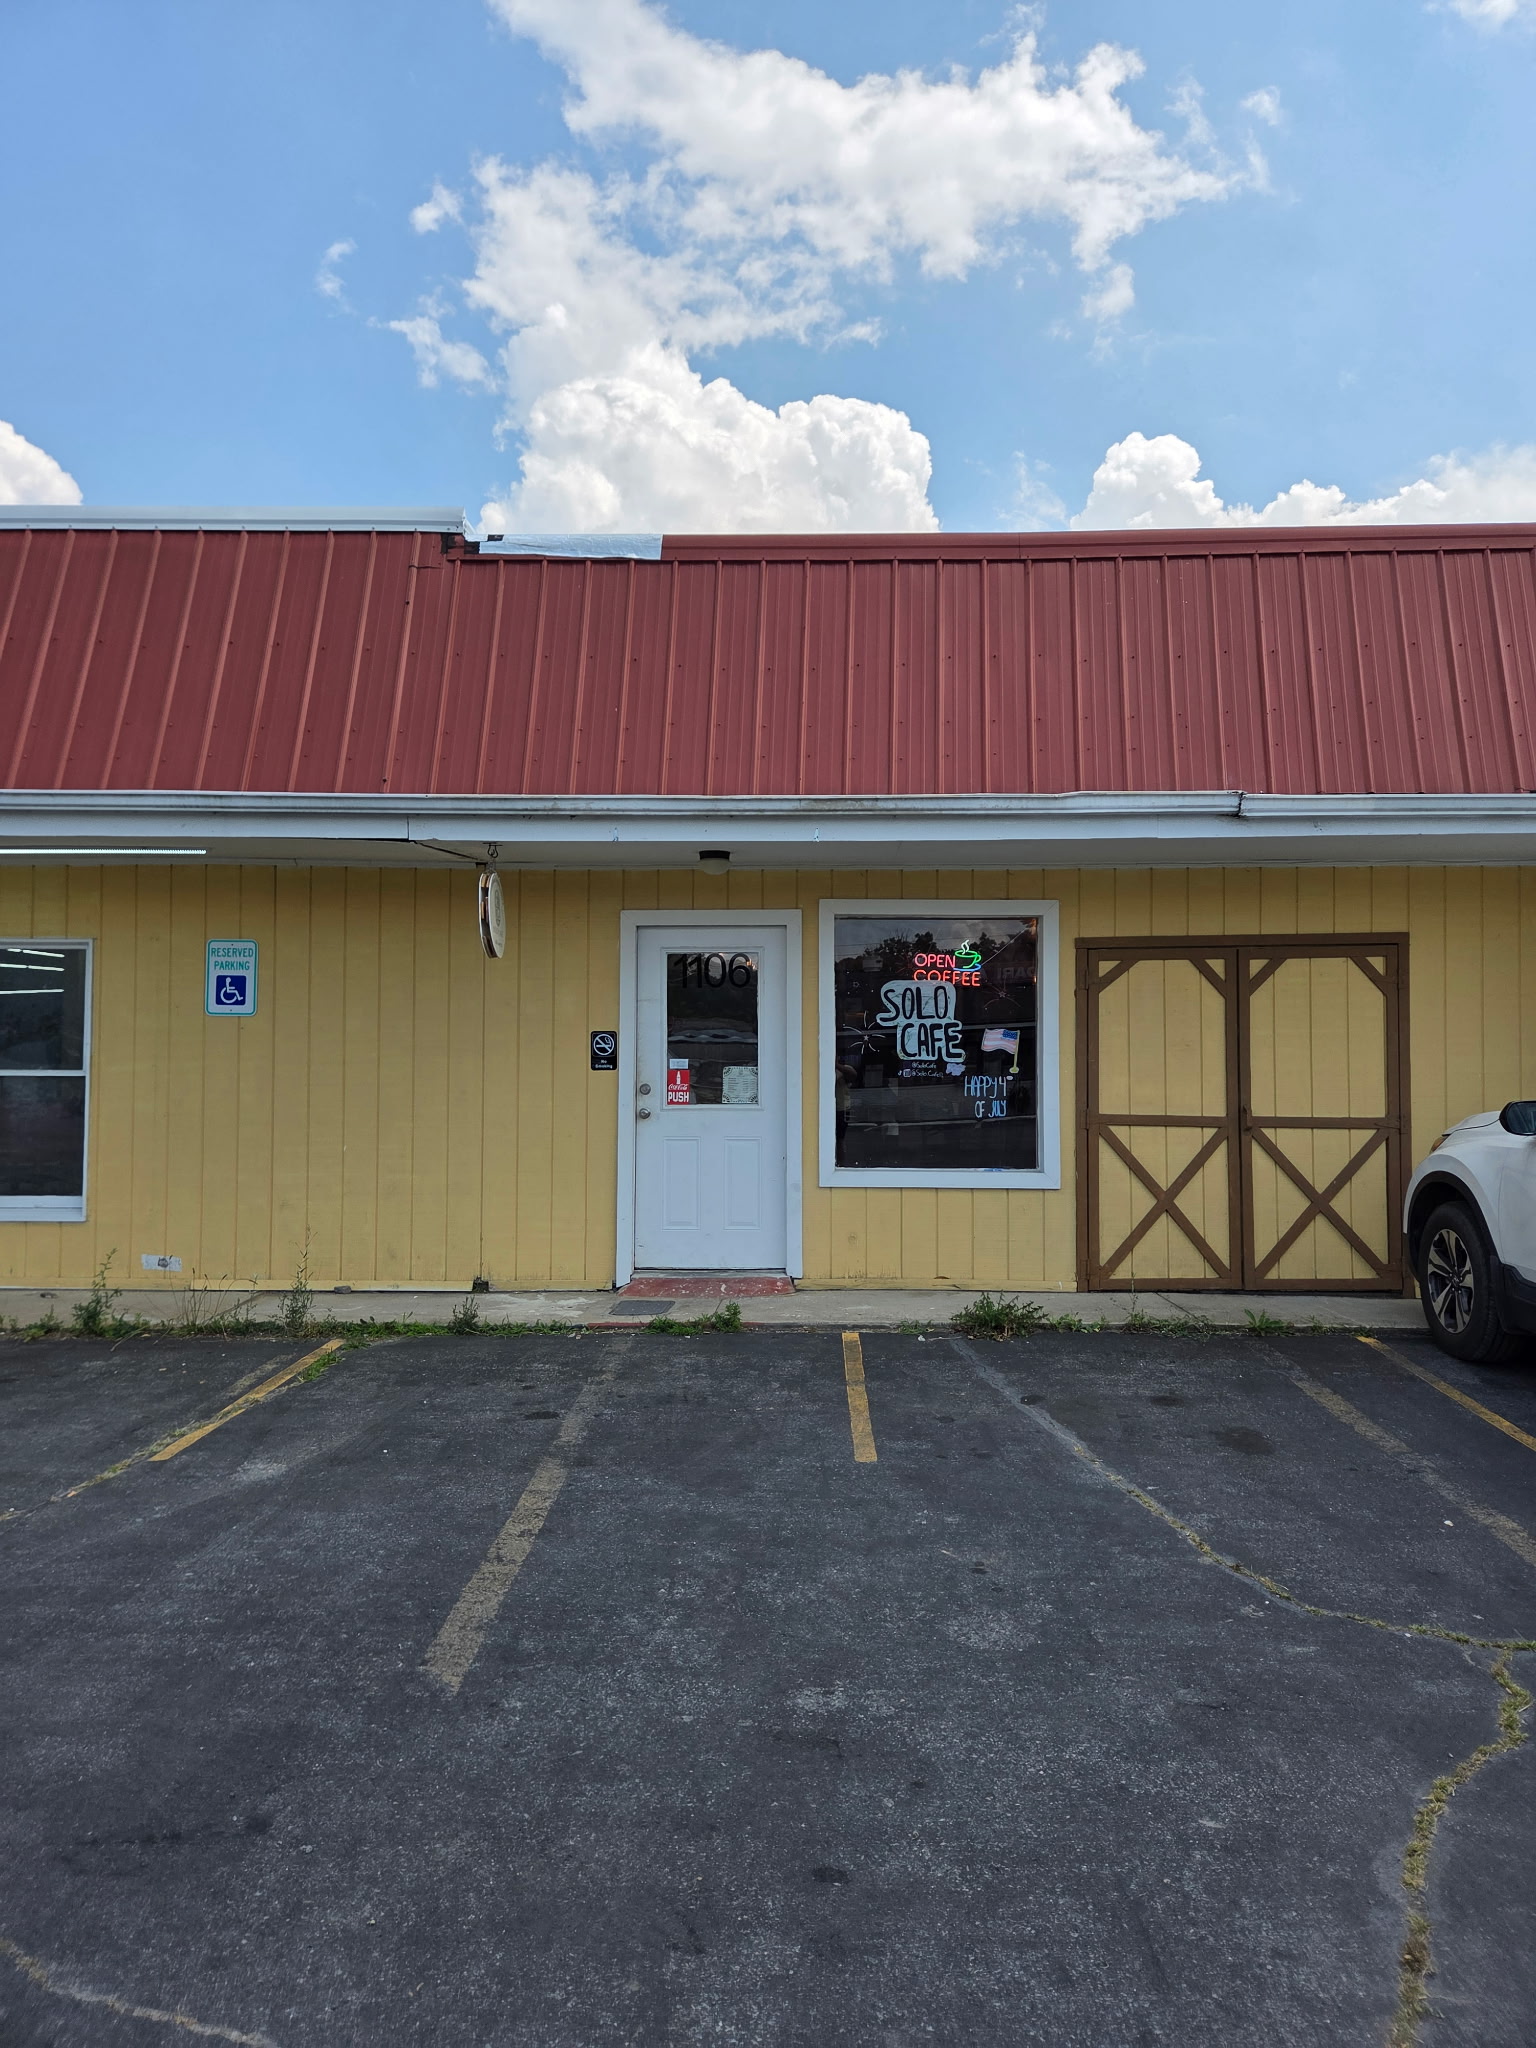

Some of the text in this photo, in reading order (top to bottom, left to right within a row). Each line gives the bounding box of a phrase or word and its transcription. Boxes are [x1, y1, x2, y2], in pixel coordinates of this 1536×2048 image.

[211, 947, 254, 958] RESERVED
[914, 953, 956, 968] OPEN
[213, 960, 250, 971] PARKING
[674, 952, 751, 989] 1106
[913, 969, 981, 987] COFFEE
[880, 985, 949, 1022] SOLO
[900, 1022, 964, 1059] CAFE
[964, 1075, 997, 1099] HAPPY
[668, 1091, 690, 1103] PUSH
[974, 1099, 1007, 1118] OF JULY
